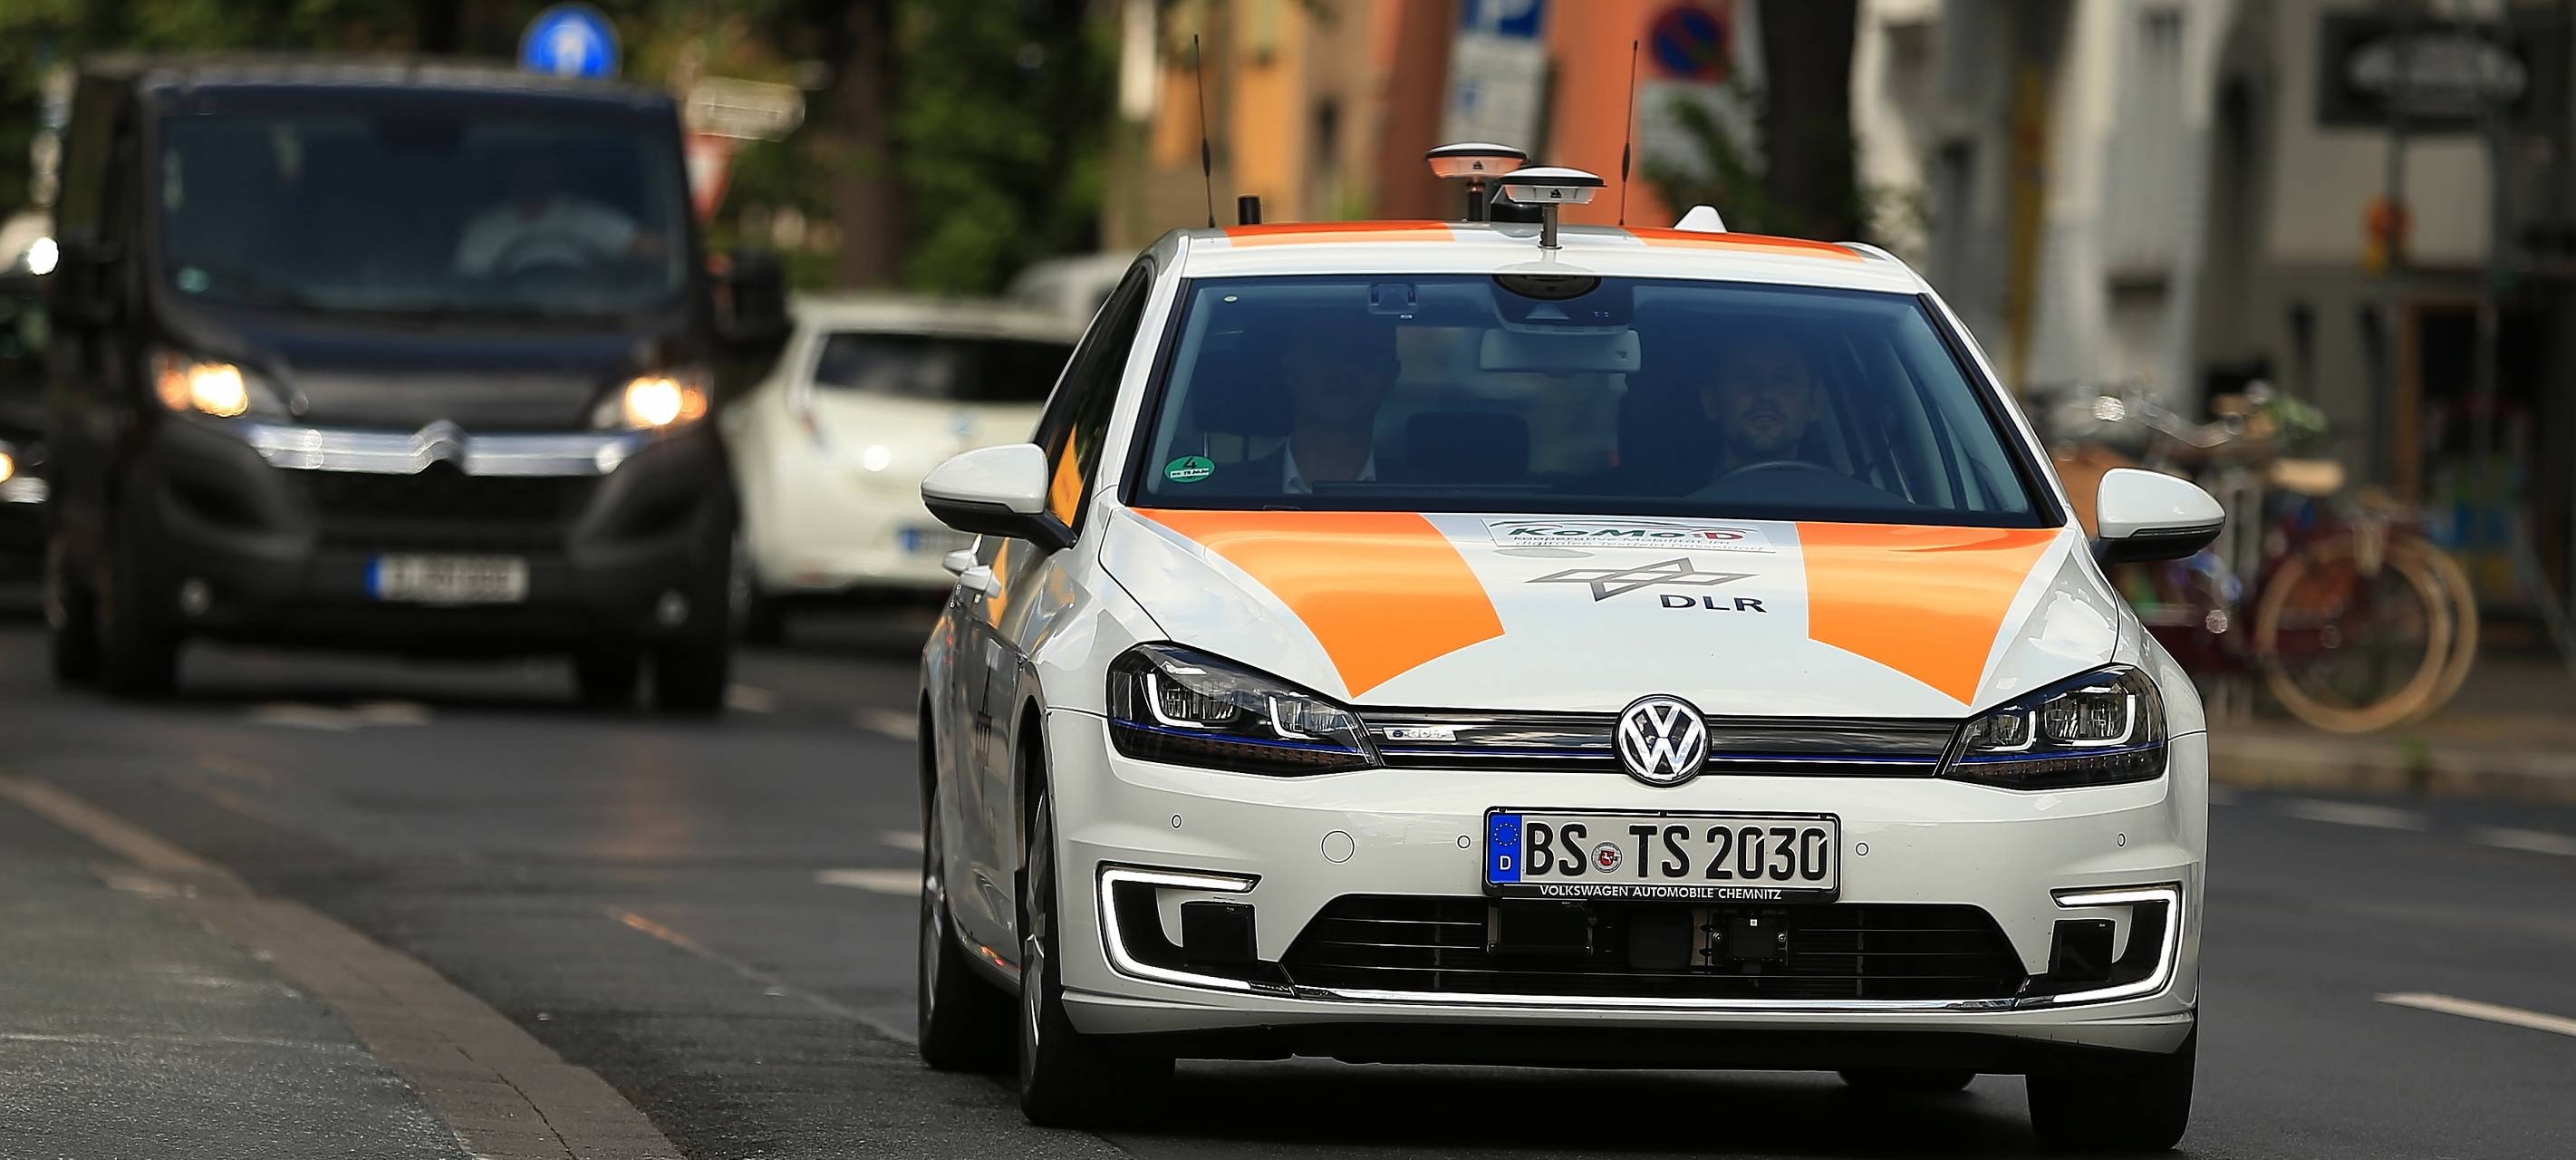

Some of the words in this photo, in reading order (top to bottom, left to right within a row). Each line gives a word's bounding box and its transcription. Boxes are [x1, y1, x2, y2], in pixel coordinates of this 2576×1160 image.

[1659, 594, 1768, 614] DLR
[1619, 696, 1705, 783] VW
[1499, 855, 1512, 871] D
[1526, 822, 1587, 876] BS
[1628, 825, 1690, 878] TS
[1705, 826, 1828, 881] 2030
[1539, 884, 1629, 896] VOLKSWAGEN
[1632, 886, 1714, 898] AUTOMOBILE
[1718, 888, 1782, 900] CHEMNITZ
